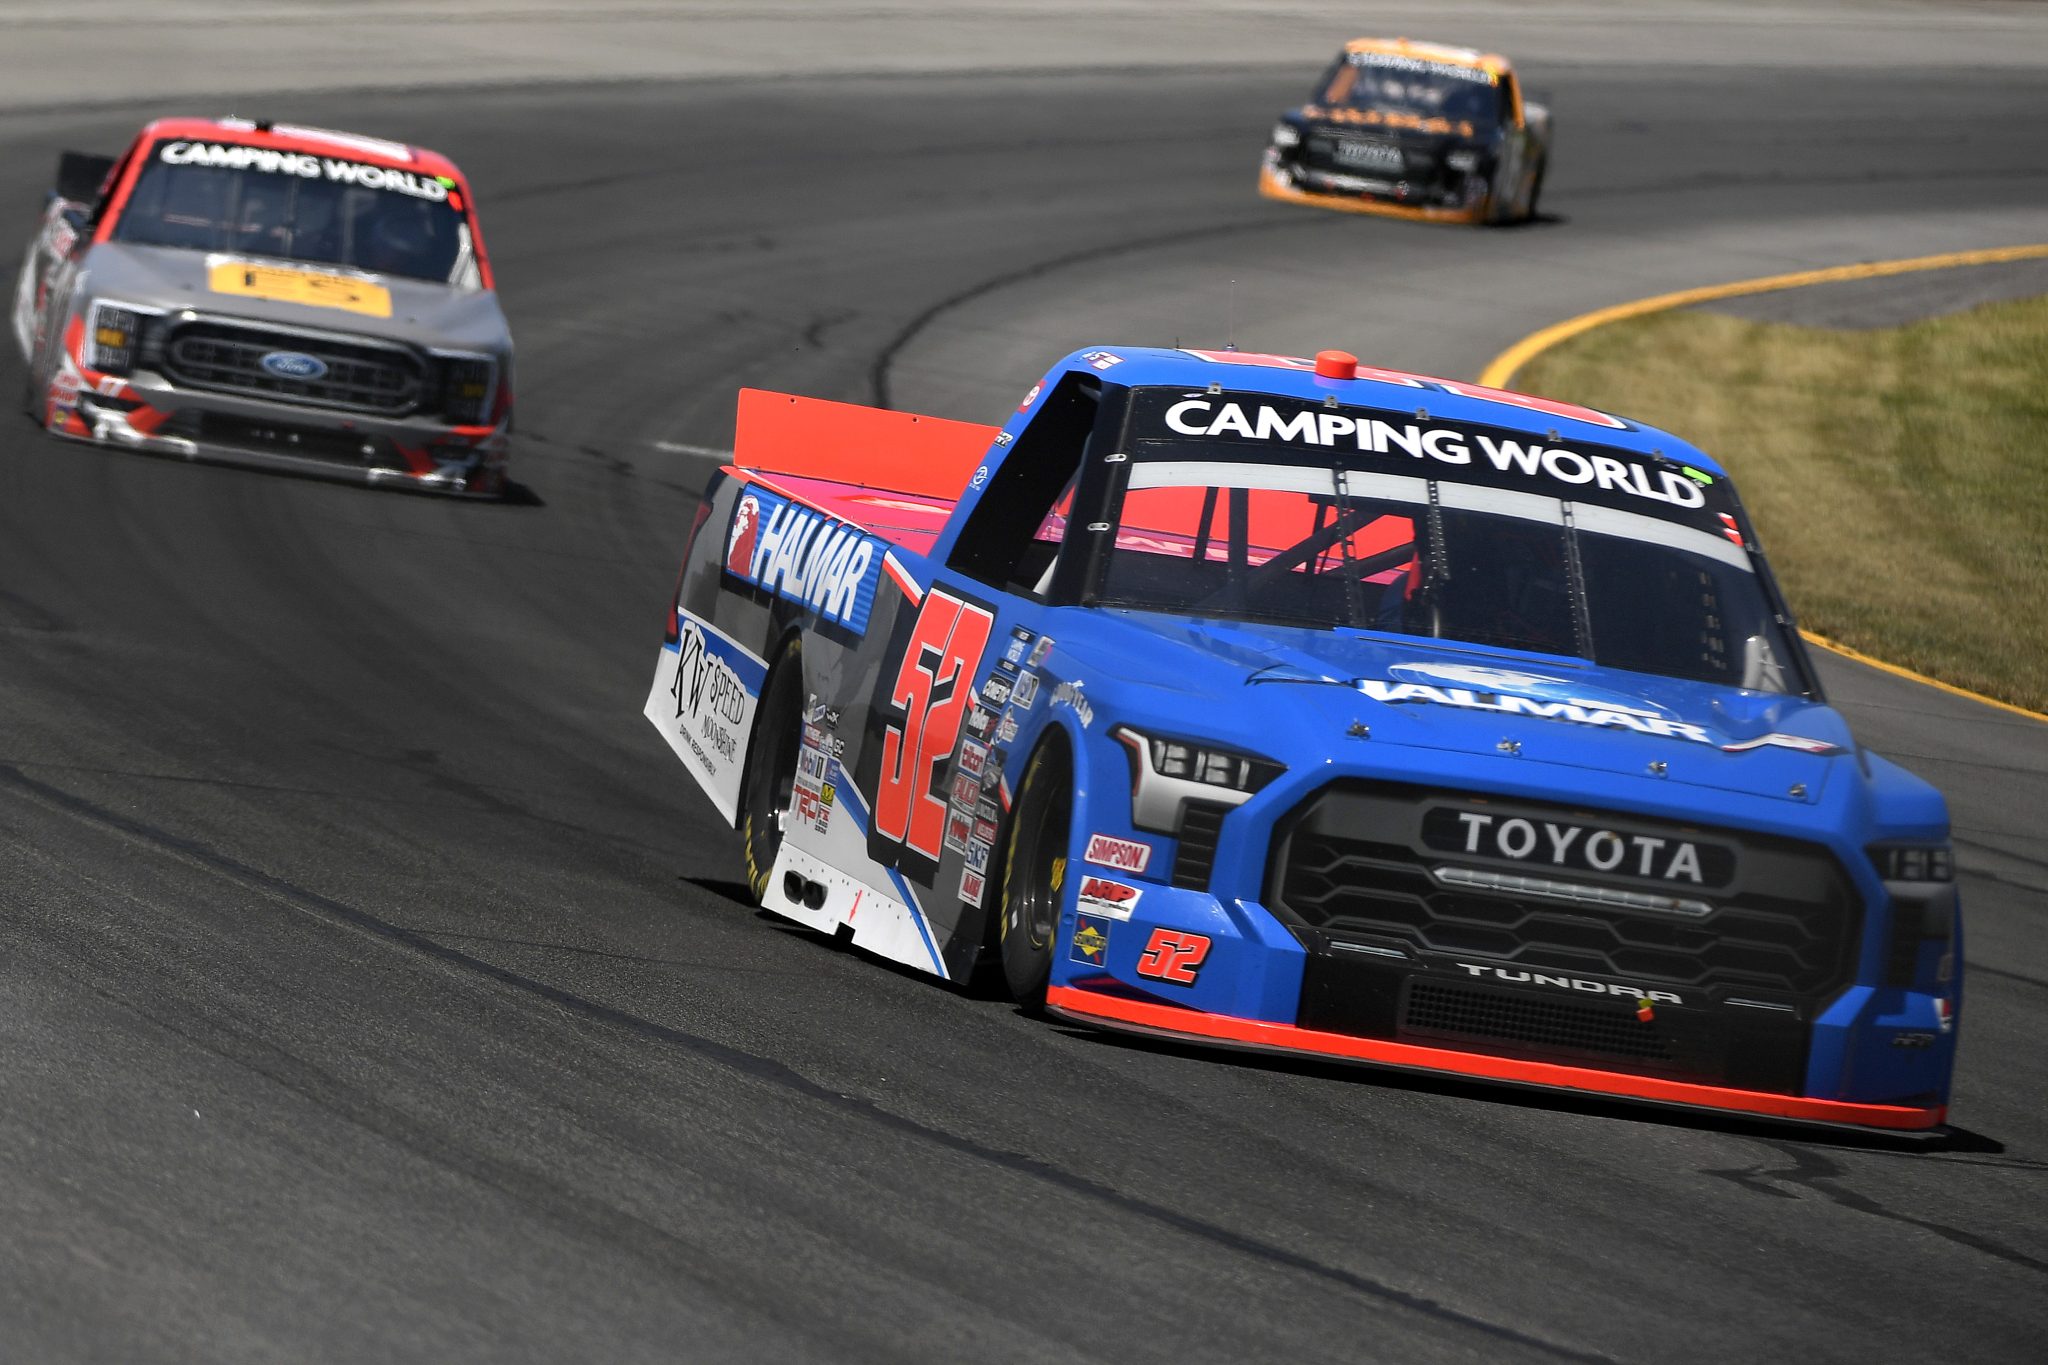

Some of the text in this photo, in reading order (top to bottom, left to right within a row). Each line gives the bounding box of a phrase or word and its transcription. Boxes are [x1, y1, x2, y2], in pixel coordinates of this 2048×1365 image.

[160, 142, 448, 201] CAMPING WORLD
[1165, 399, 1706, 509] CAMPING WORLD
[751, 503, 874, 622] HALMAR
[670, 628, 745, 725] KW SPEED
[679, 724, 692, 745] DRINK
[702, 714, 738, 764] MOONSHINE
[875, 587, 994, 862] 52
[1088, 837, 1145, 869] SIMPSON
[1458, 812, 1703, 883] TOYOTA
[1081, 878, 1137, 903] ARP
[1136, 928, 1212, 984] 52
[1455, 962, 1684, 1005] TUNDRA
